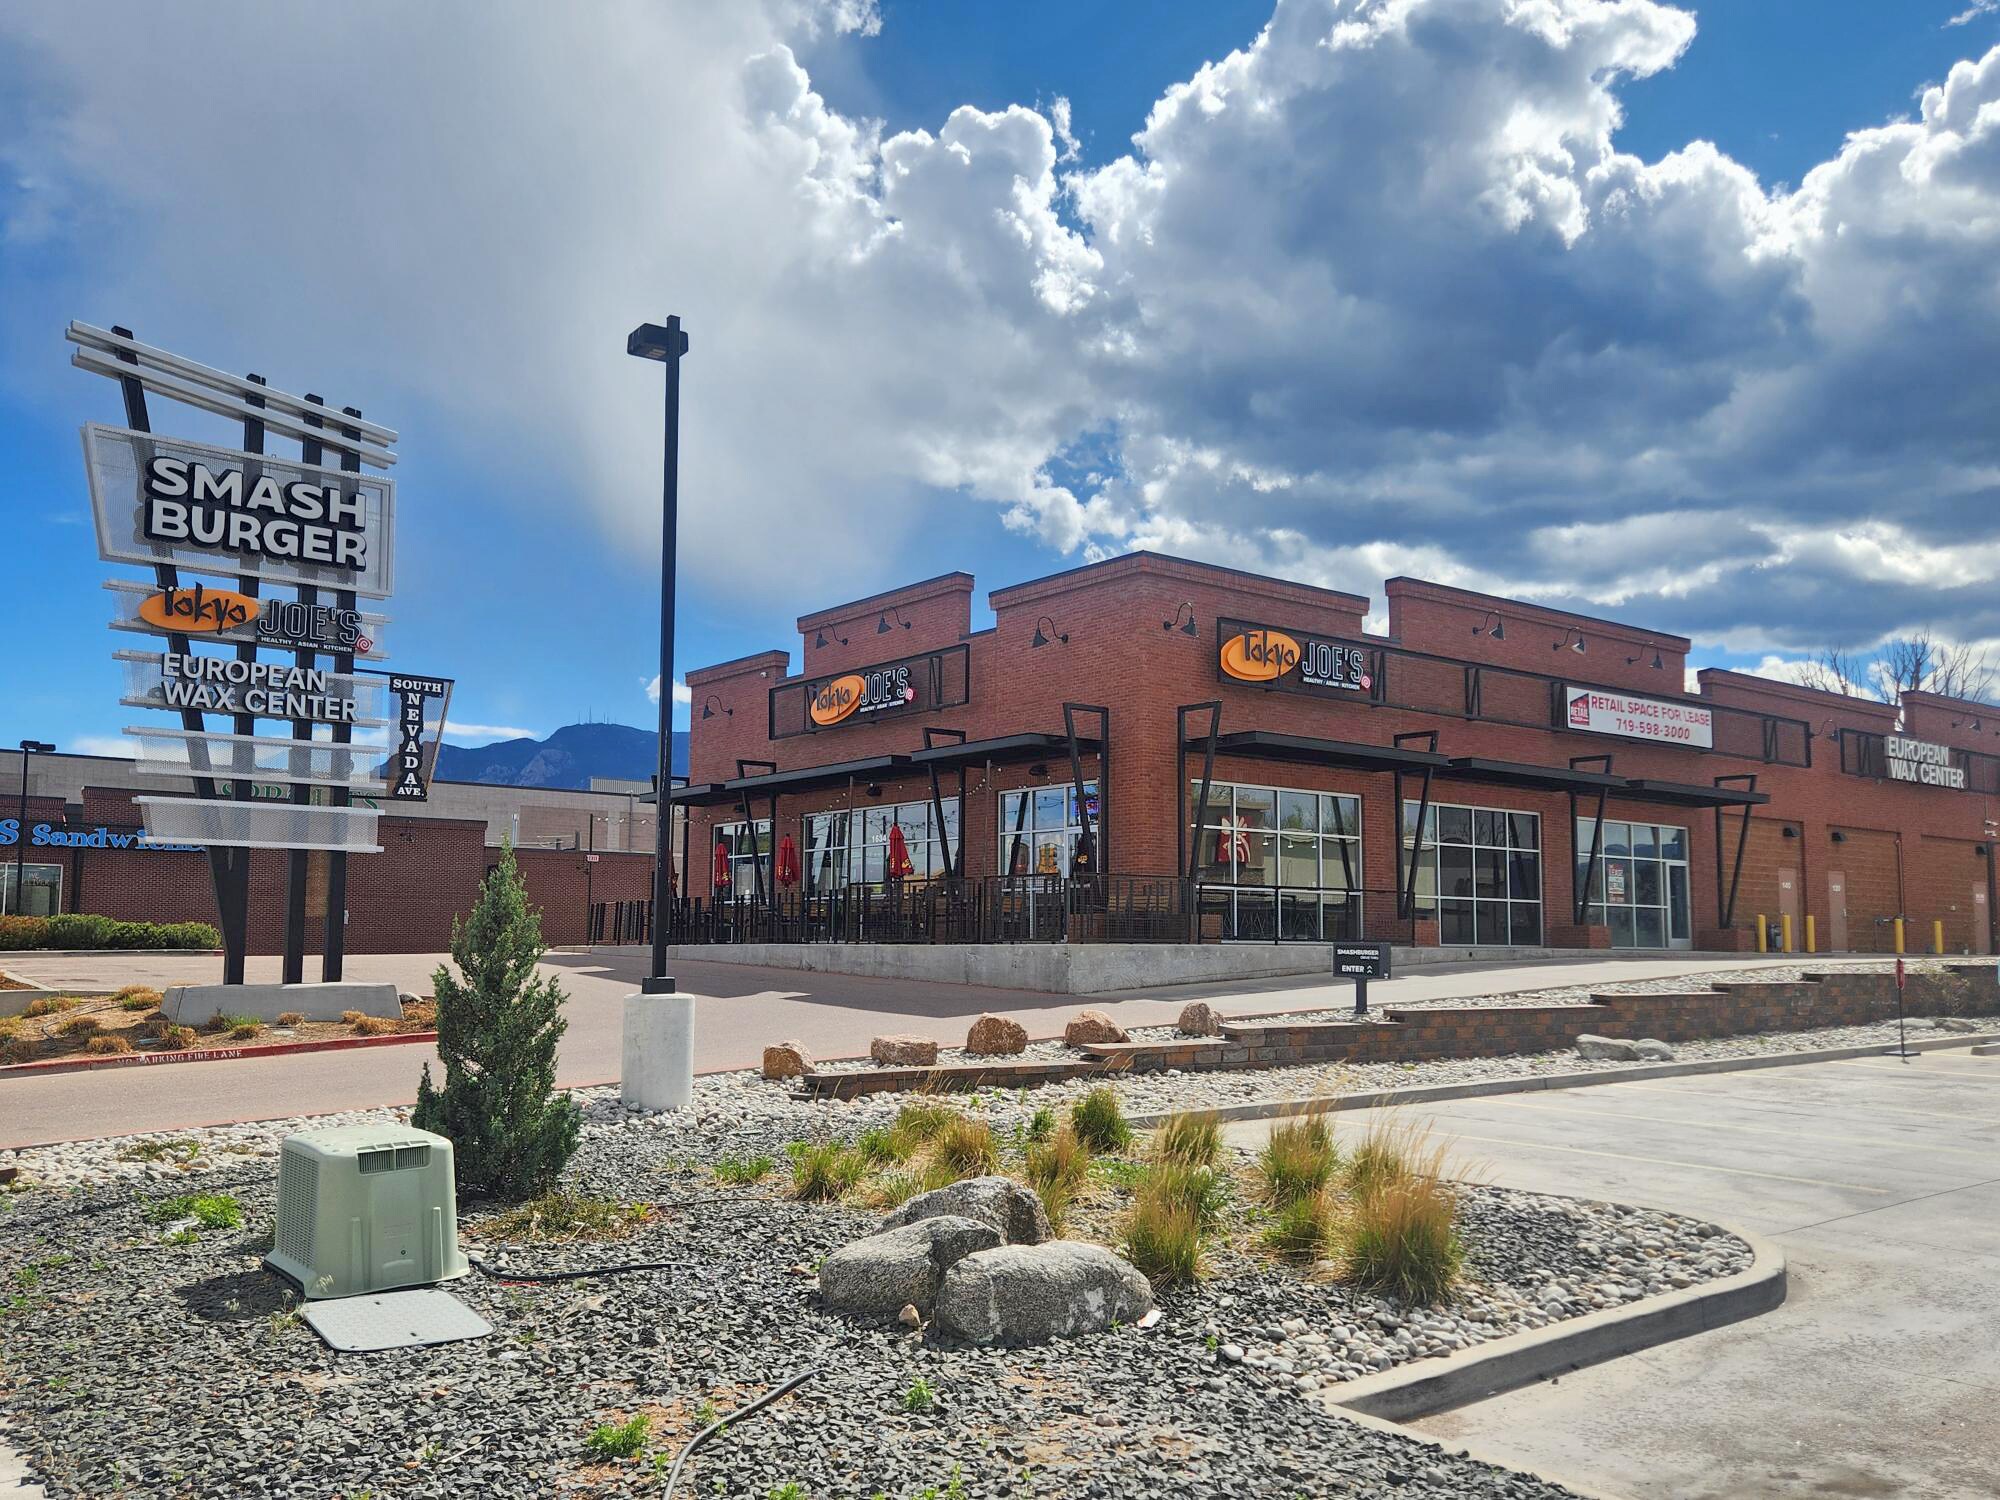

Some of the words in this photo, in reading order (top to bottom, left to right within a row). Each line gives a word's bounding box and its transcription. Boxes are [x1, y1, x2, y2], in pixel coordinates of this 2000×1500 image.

[149, 458, 366, 528] SMASH
[150, 499, 366, 568] BURGER
[157, 582, 248, 635] Tokyo
[259, 599, 362, 645] JOE'S
[261, 636, 292, 645] HEALTHY
[297, 641, 318, 649] ASIAN
[323, 644, 352, 653] KITCHEN
[1241, 630, 1295, 679] Tokyo
[1302, 642, 1364, 684] JOE'S
[162, 653, 326, 693] EUROPEAN
[393, 679, 442, 693] SOUTH
[860, 667, 908, 706] JOE'S
[163, 681, 235, 711] WAX
[245, 689, 358, 722] CENTER
[1591, 695, 1624, 713] RETAIL
[1628, 702, 1659, 718] SPACE
[1662, 707, 1681, 720] FOR
[1683, 711, 1710, 726] LEASE
[405, 692, 421, 785] NEVADA
[1616, 718, 1690, 740] 719-598-3000
[1886, 736, 1949, 766] EUROPEAN
[1889, 758, 1917, 782] WAX
[1921, 764, 1964, 788] CENTER
[397, 787, 425, 796] AVE.
[32, 823, 207, 852] Sandwi
[1342, 965, 1365, 973] ENTER
[136, 1053, 184, 1065] PARKING
[187, 1051, 209, 1061] FIRE
[213, 1049, 243, 1059] LANE
